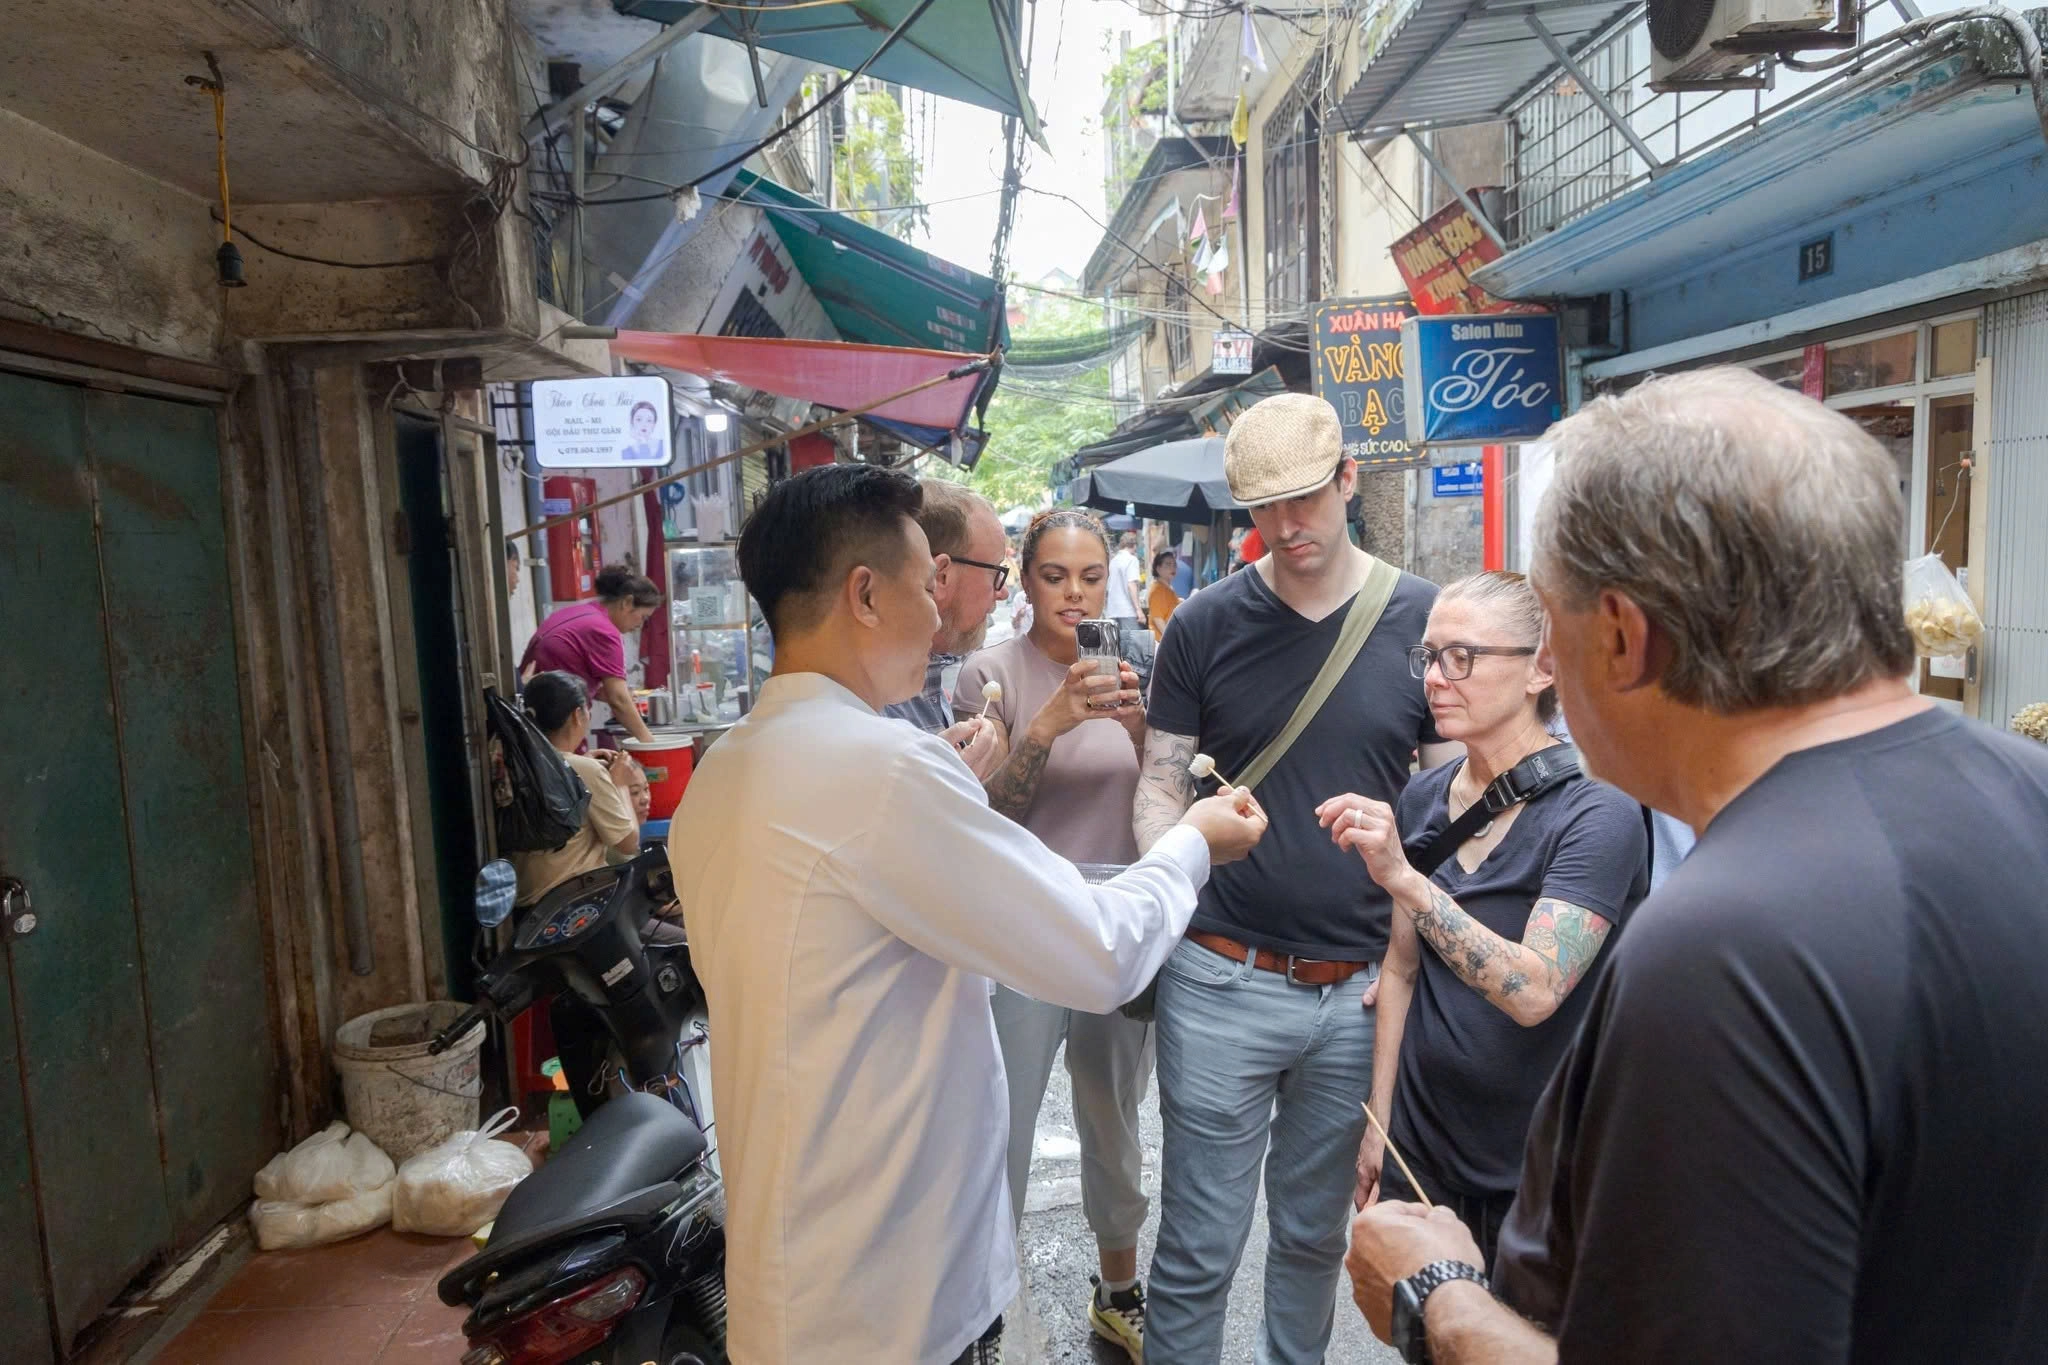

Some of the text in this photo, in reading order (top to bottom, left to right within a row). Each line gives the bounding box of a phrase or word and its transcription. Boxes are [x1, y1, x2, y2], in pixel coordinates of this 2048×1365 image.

[1807, 244, 1825, 273] 15
[1329, 309, 1379, 333] XUÂN
[1451, 321, 1523, 341] Salon Mun
[1429, 347, 1551, 413] Tóc
[564, 416, 584, 425] NAIL
[1341, 388, 1406, 435] BẠC
